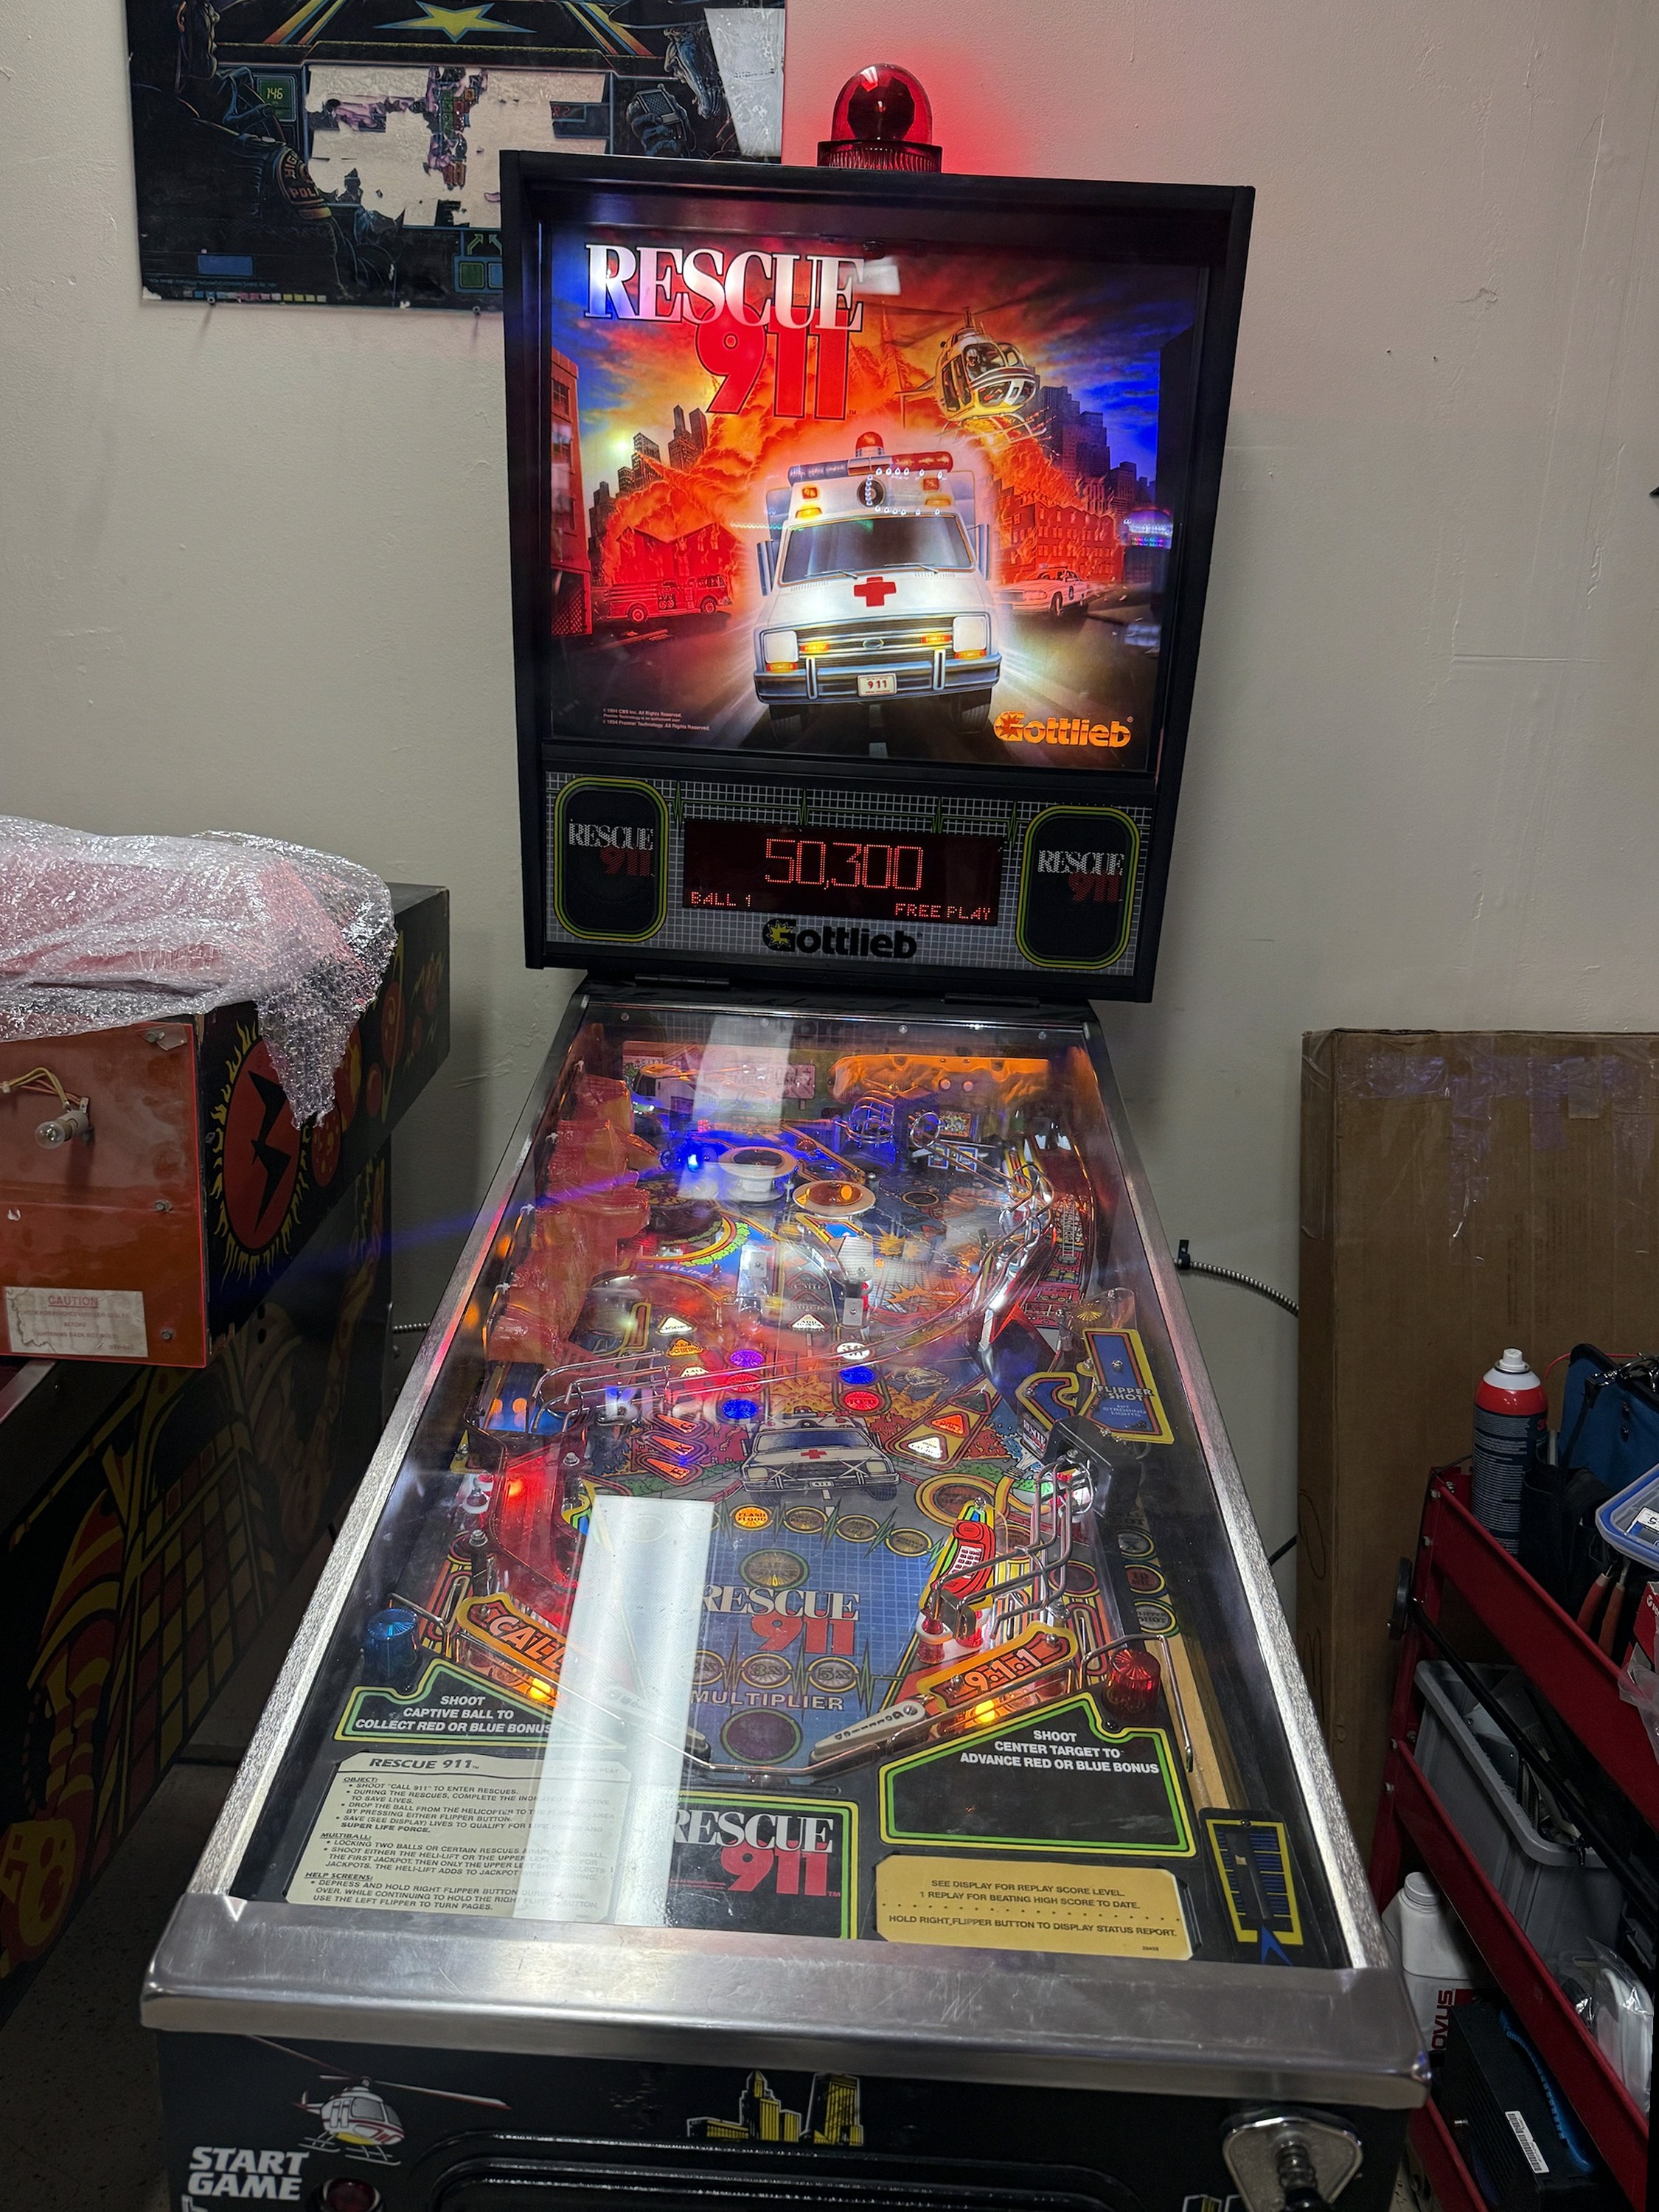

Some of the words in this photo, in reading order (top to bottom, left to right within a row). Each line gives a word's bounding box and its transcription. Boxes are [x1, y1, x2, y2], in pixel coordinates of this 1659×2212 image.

[267, 88, 283, 100] 146
[584, 244, 864, 333] RESCUE
[695, 303, 851, 421] 911
[868, 680, 887, 689] 911
[993, 710, 1131, 748] Gottlieb
[568, 821, 654, 850] RESCUE
[601, 846, 654, 877] 911
[765, 838, 924, 891] 50,300
[1037, 850, 1124, 876] RESCUE
[1068, 873, 1121, 902] 911
[691, 891, 737, 907] BALL
[745, 894, 752, 908] 1
[895, 903, 942, 918] FREE
[946, 905, 992, 921] PLAY
[762, 918, 917, 959] Gottlieb
[48, 1295, 99, 1307] CAUTION
[1096, 1385, 1155, 1397] FLIPPER
[1108, 1392, 1144, 1401] SHOT
[701, 1585, 860, 1621] RESCUE
[751, 1609, 855, 1655] 911
[440, 1696, 485, 1706] SHOOT
[691, 1689, 845, 1711] MULTIPLIER
[403, 1707, 459, 1719] CAPTIVE
[461, 1709, 493, 1719] BALL
[497, 1710, 514, 1719] TO
[355, 1719, 416, 1731] COLLECT
[417, 1721, 445, 1731] RED
[448, 1722, 467, 1732] OR
[470, 1722, 505, 1733] BLUE
[507, 1723, 552, 1733] BONUS
[1033, 1730, 1077, 1742] SHOOT
[995, 1741, 1048, 1754] CENTER
[1050, 1745, 1100, 1758] TARGET
[1102, 1748, 1121, 1758] TO
[369, 1758, 437, 1769] RESCUE
[442, 1759, 471, 1769] 911
[960, 1753, 1021, 1767] ADVANCE
[1023, 1757, 1052, 1769] RED
[1054, 1759, 1074, 1770] OR
[1076, 1760, 1111, 1771] BLUE
[1113, 1762, 1160, 1774] BONUS
[675, 1809, 834, 1853] RESCUE
[720, 1839, 828, 1896] 911
[375, 1891, 431, 1899] CONTINUING
[989, 1895, 1031, 1903] BEATING
[1431, 1989, 1453, 2051] OVUS
[189, 2146, 310, 2175] START
[188, 2171, 302, 2201] GAME
